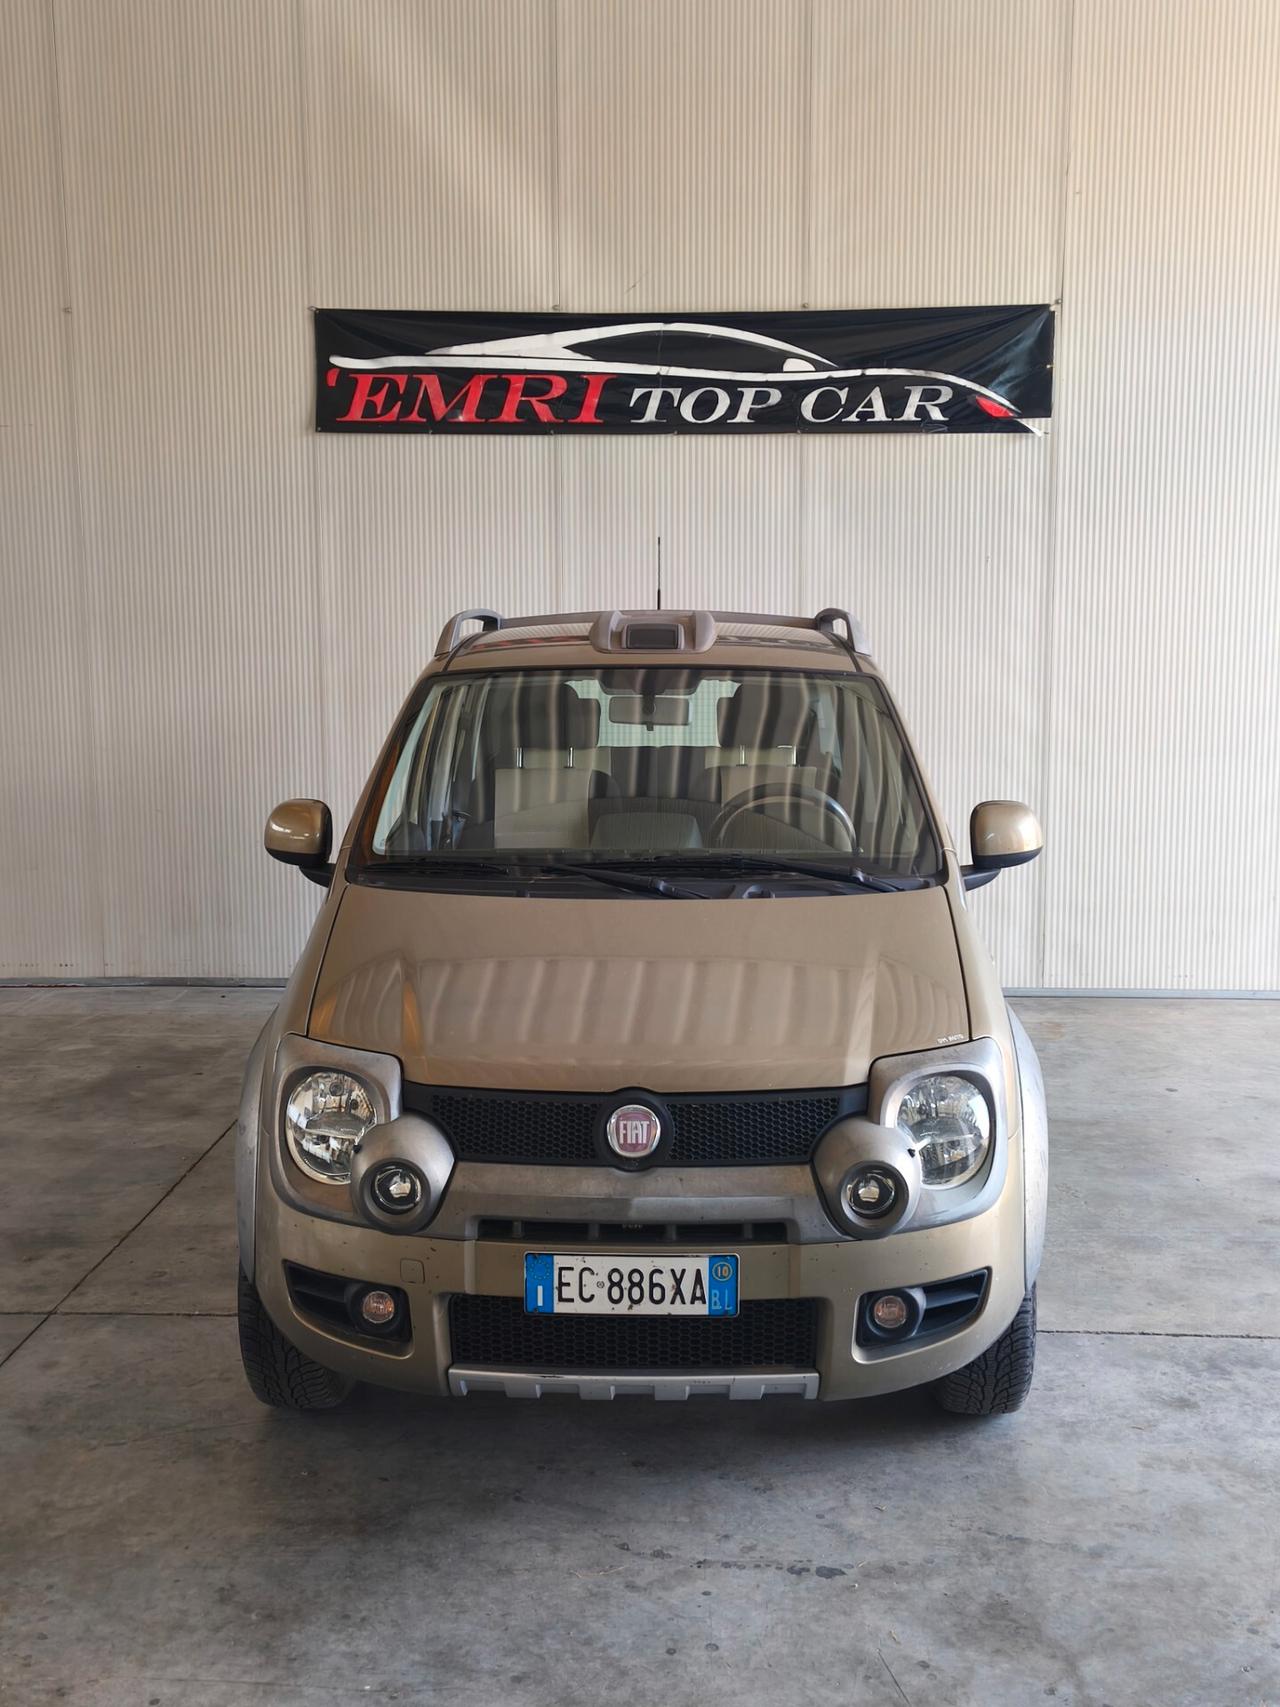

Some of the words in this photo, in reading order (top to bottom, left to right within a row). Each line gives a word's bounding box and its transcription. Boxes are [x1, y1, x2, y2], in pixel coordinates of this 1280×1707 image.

[629, 387, 782, 424] TOP
[801, 385, 953, 422] CAR
[619, 1120, 650, 1144] FIAT
